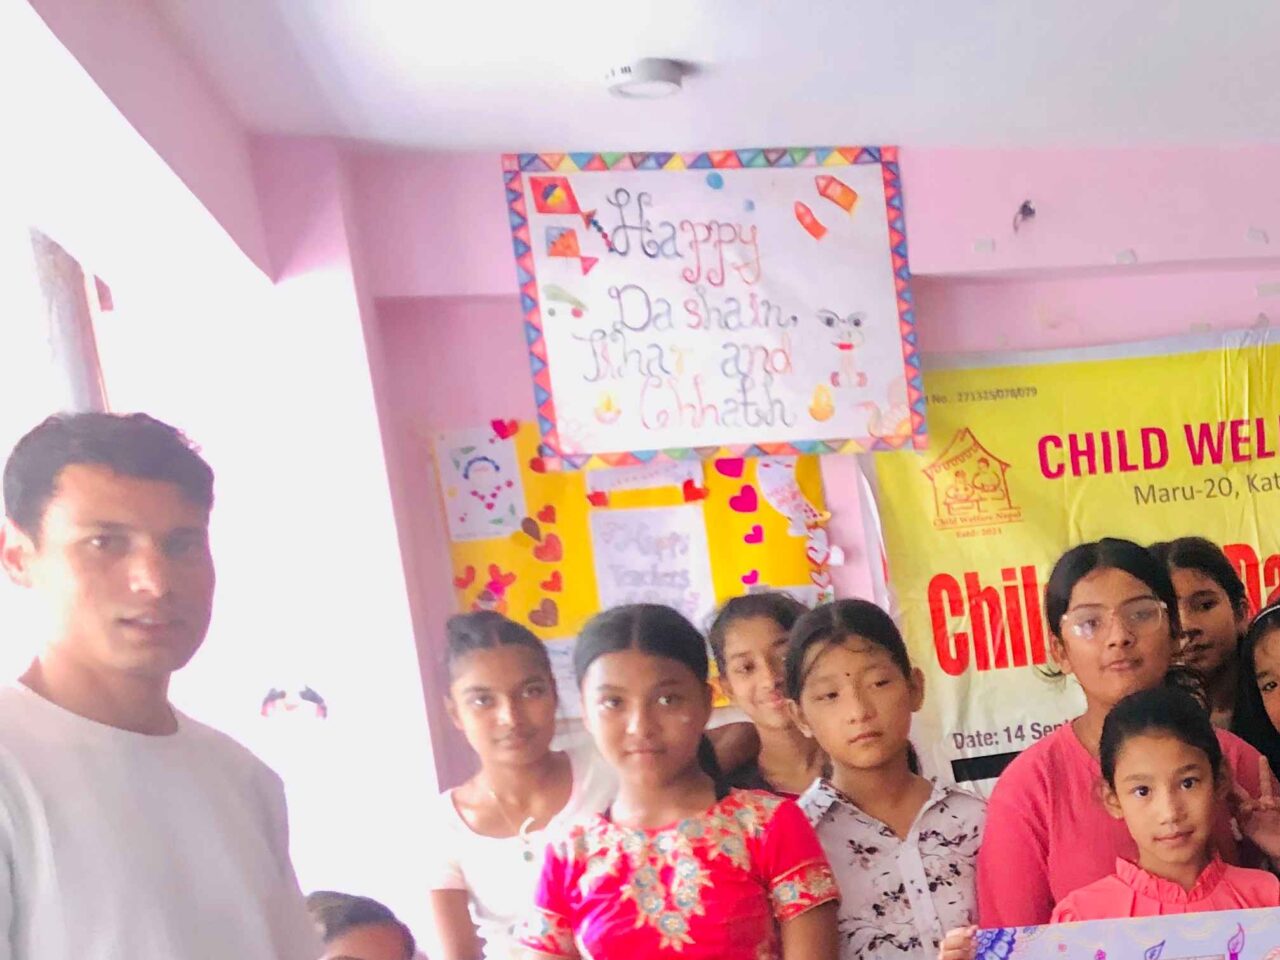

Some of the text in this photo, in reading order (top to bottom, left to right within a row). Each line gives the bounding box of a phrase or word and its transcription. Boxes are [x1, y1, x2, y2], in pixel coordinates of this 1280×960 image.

[607, 187, 761, 287] Happy
[721, 331, 793, 379] and
[640, 374, 798, 430] Chhath
[1038, 426, 1170, 480] CHILD
[1134, 476, 1240, 506] Maru-20,
[928, 565, 1048, 676] Chil
[953, 719, 1069, 750] Date: 14 Se
